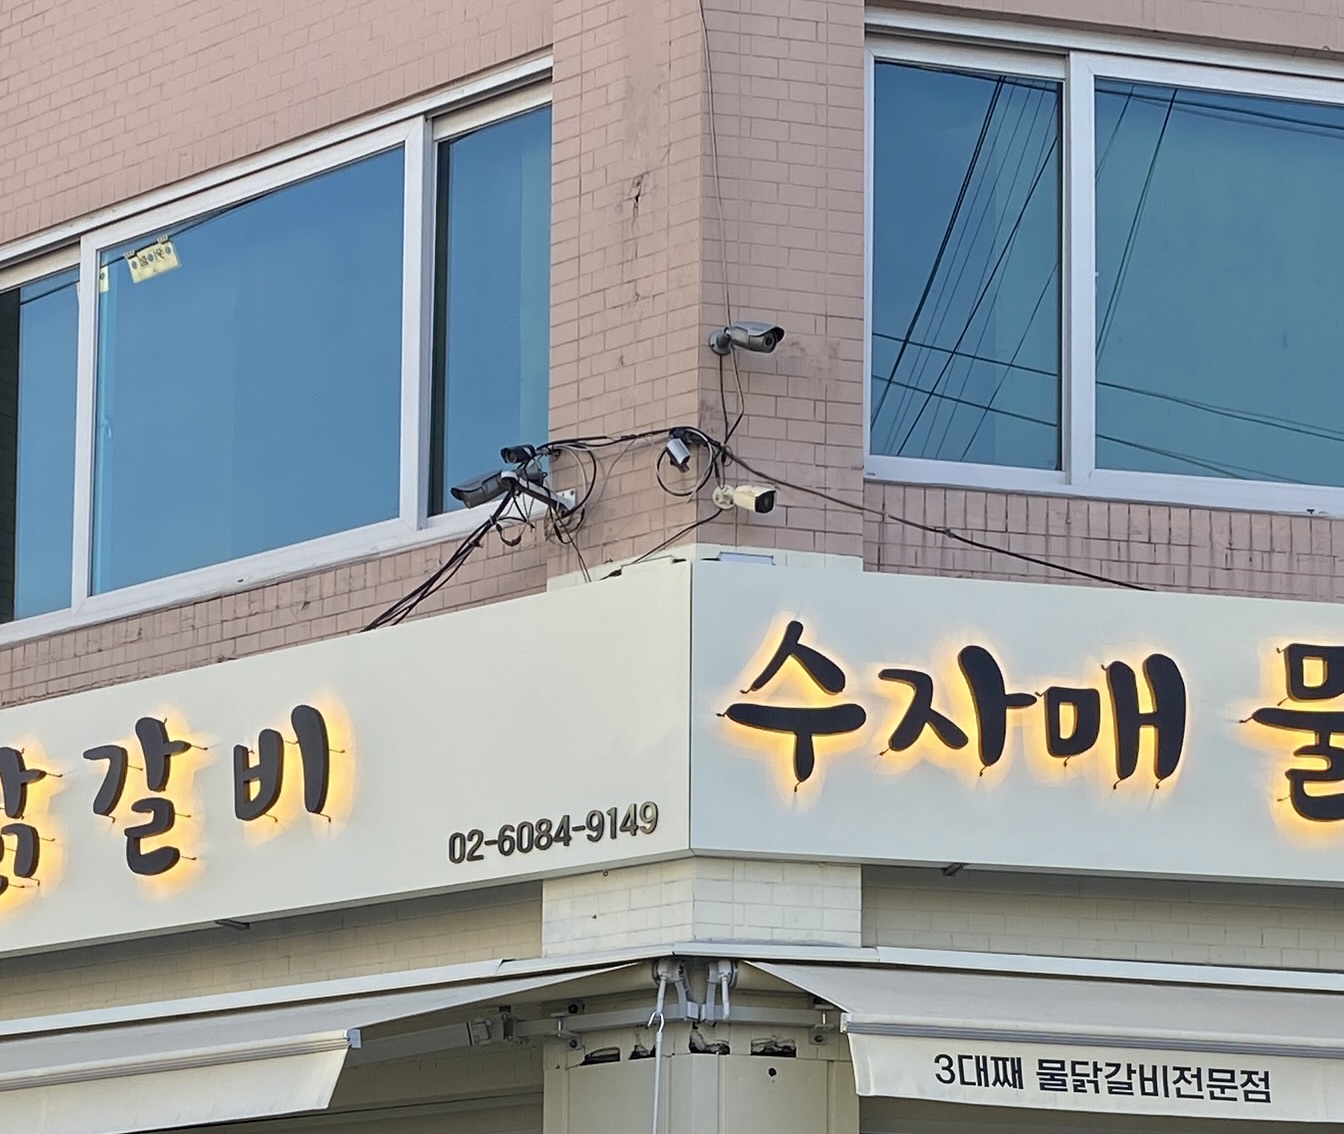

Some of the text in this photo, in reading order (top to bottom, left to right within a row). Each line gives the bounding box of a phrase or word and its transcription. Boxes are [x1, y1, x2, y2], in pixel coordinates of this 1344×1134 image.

[726, 619, 1187, 783] 수자매
[448, 801, 659, 864] 02-6084-9149
[934, 1053, 1272, 1103] 3대째 물닭갈비전문점
